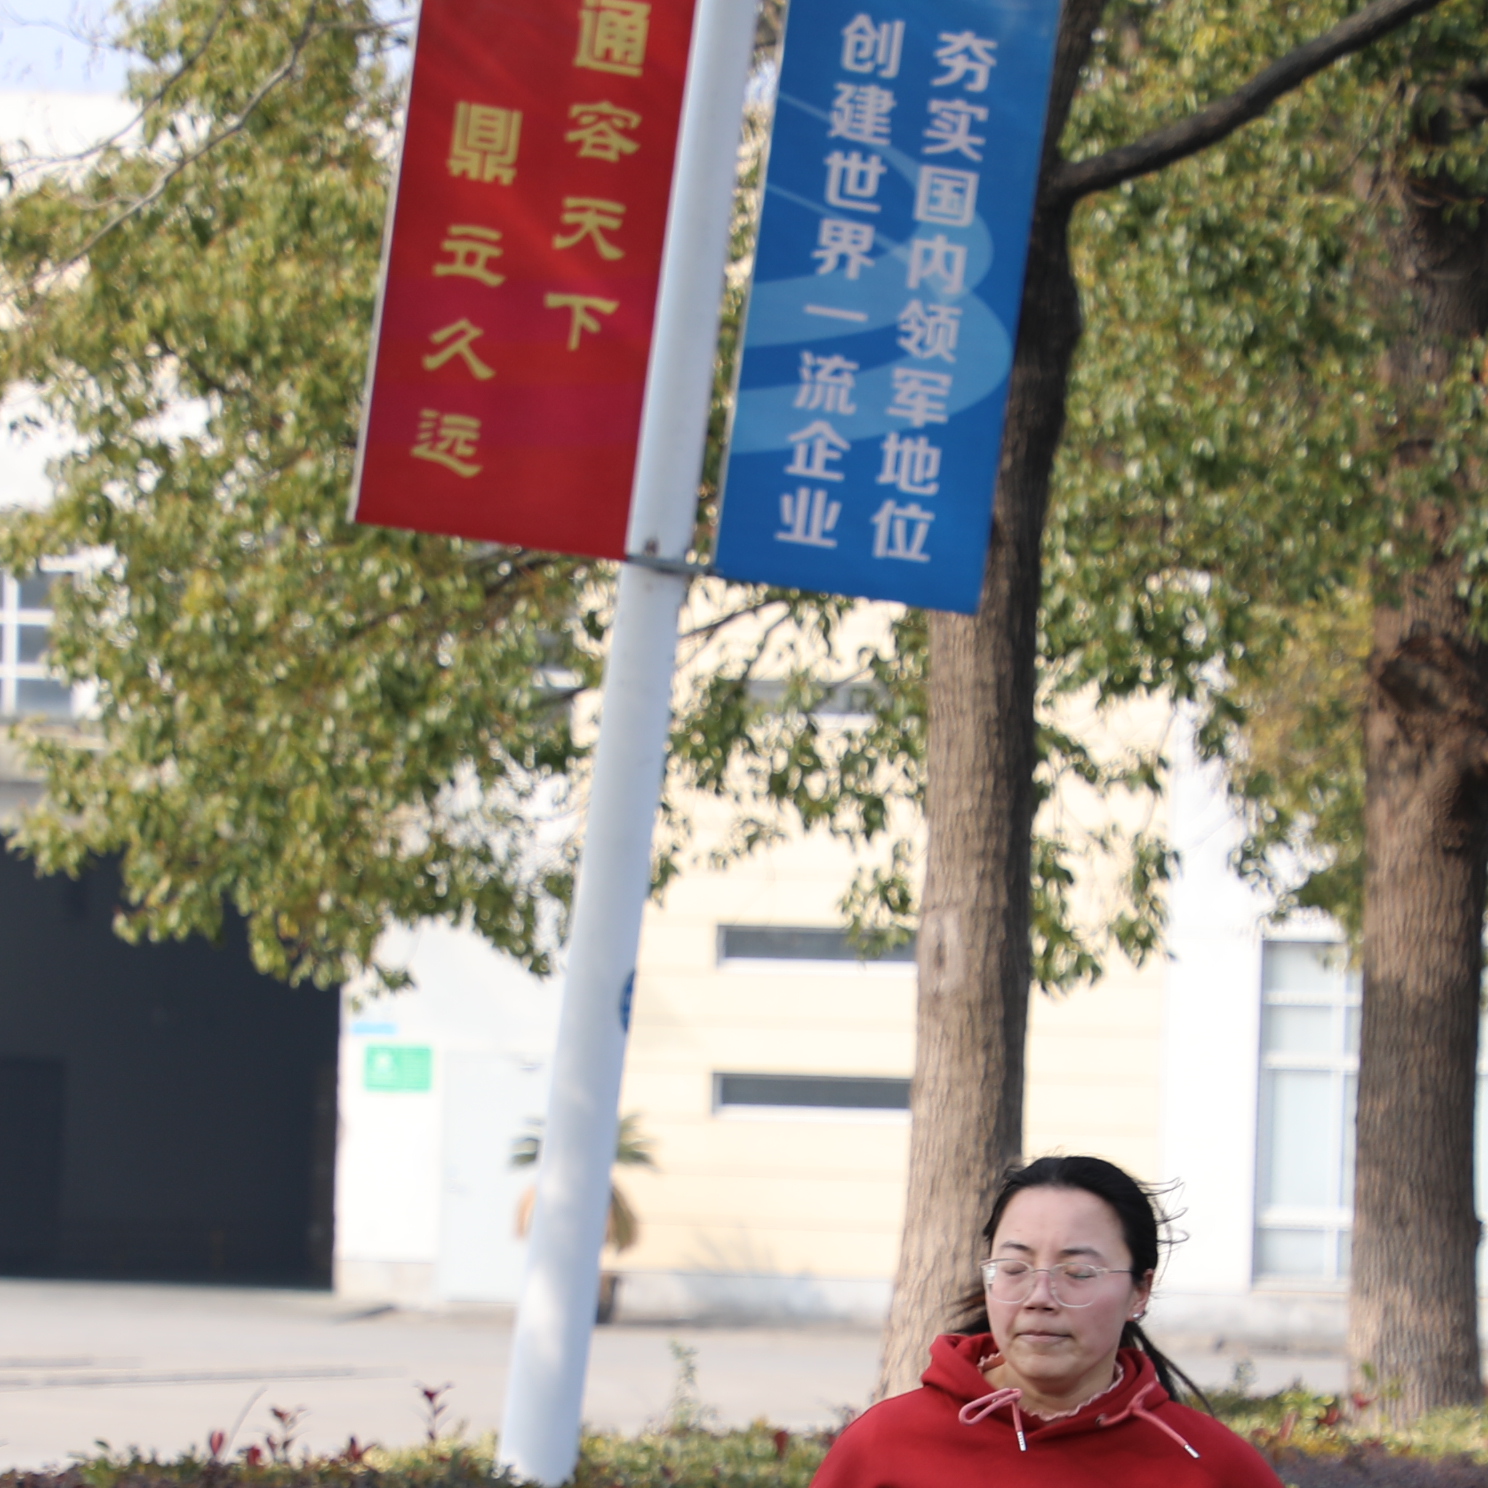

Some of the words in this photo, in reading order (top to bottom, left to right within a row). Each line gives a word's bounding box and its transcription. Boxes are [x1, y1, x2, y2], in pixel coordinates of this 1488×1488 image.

[410, 100, 524, 478] 鼎立久远
[543, 0, 652, 352] 通容天下
[774, 13, 906, 548] 创建世界一流企业
[870, 30, 999, 564] 夯实国内领军地位
